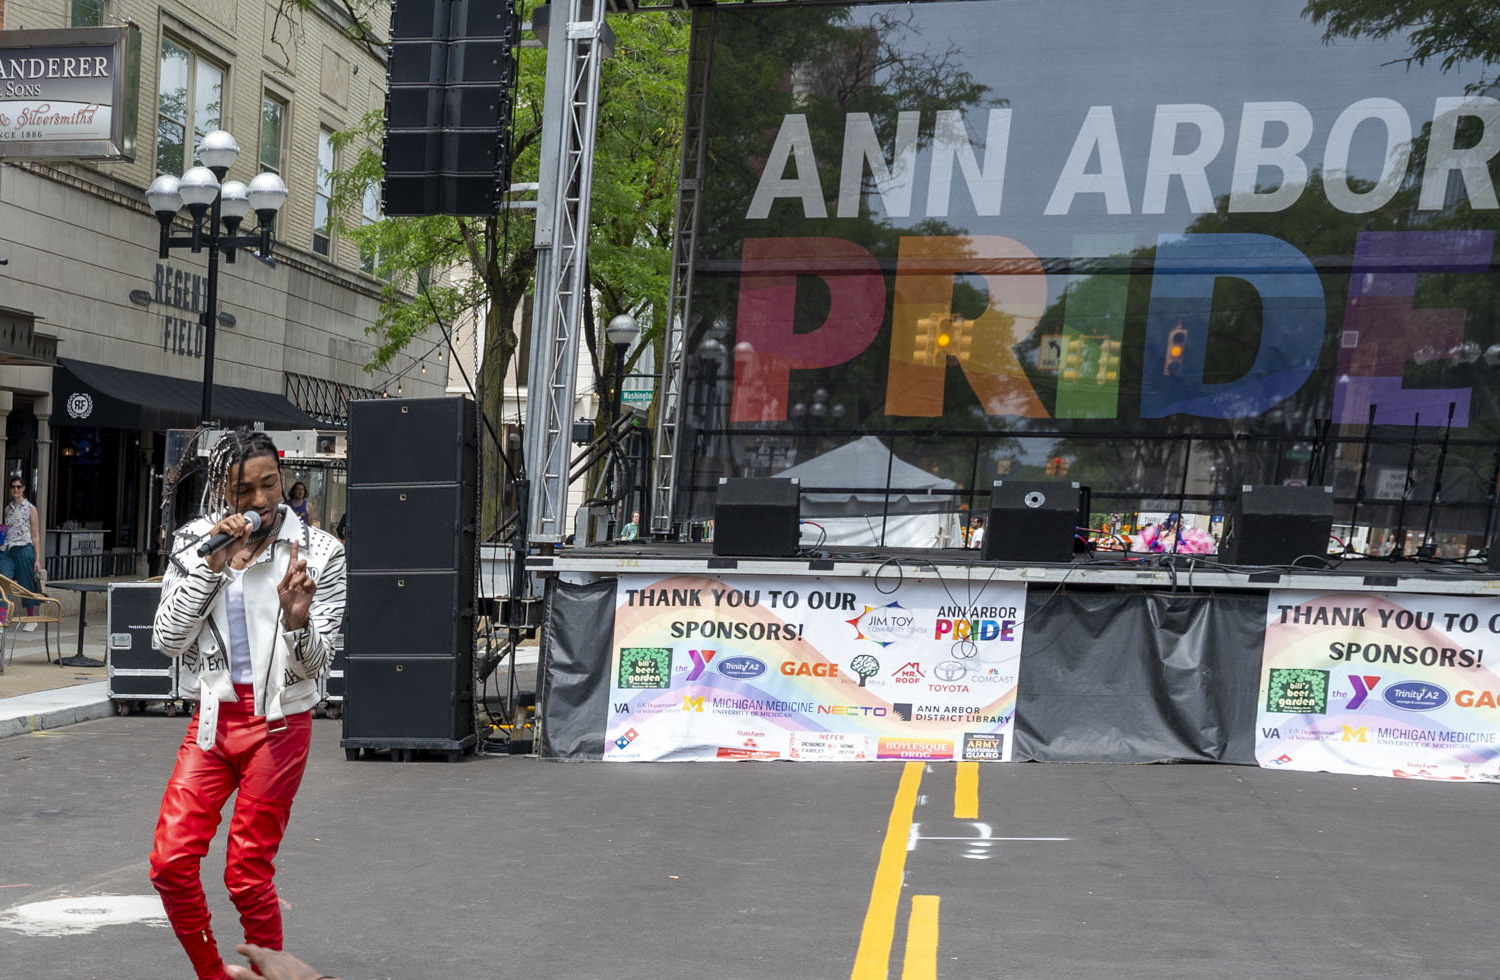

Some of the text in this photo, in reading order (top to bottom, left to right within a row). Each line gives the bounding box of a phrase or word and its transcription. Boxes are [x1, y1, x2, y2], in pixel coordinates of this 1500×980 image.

[14, 104, 100, 131] Silversmiths
[746, 97, 1500, 219] ANN ARBOR
[729, 229, 1495, 428] PRIDE
[163, 315, 204, 359] FIELD
[626, 588, 857, 611] THANK YOU TO OUR
[937, 605, 1017, 619] ANN ARBOR
[868, 616, 914, 627] JIM TOY
[1277, 605, 1367, 627] THANK
[1378, 608, 1435, 631] YOU
[1443, 612, 1479, 633] TO
[670, 620, 804, 641] SPONSORS!
[934, 619, 1016, 642] PRIDE
[1328, 641, 1484, 668] SPONSORS!
[635, 666, 655, 674] beer
[675, 665, 689, 673] the
[725, 662, 749, 672] Trinity
[780, 661, 839, 677] GAGE
[628, 673, 661, 684] garden
[971, 675, 1015, 684] COMCAST
[929, 684, 970, 693] TOYOTA
[1289, 682, 1310, 690] bill's
[1286, 688, 1309, 697] beer
[1332, 690, 1348, 698] the
[1394, 688, 1440, 701] Trinity A2
[614, 703, 630, 714] VA
[682, 696, 706, 712] M
[713, 698, 814, 713] MICHIGAN MEDICINE
[1278, 697, 1316, 708] garden
[817, 705, 887, 717] NECTO
[916, 705, 981, 714] ANN ARBOR
[915, 713, 1012, 724] DISTRICT LIBRARY
[1262, 727, 1281, 739] VA
[1341, 725, 1368, 743] M
[1377, 727, 1497, 744] MICHIGAN MEDICINE
[885, 742, 947, 752] BOYLESQUE
[967, 740, 1000, 748] ARMY
[1377, 739, 1419, 748] UNIVERSITY
